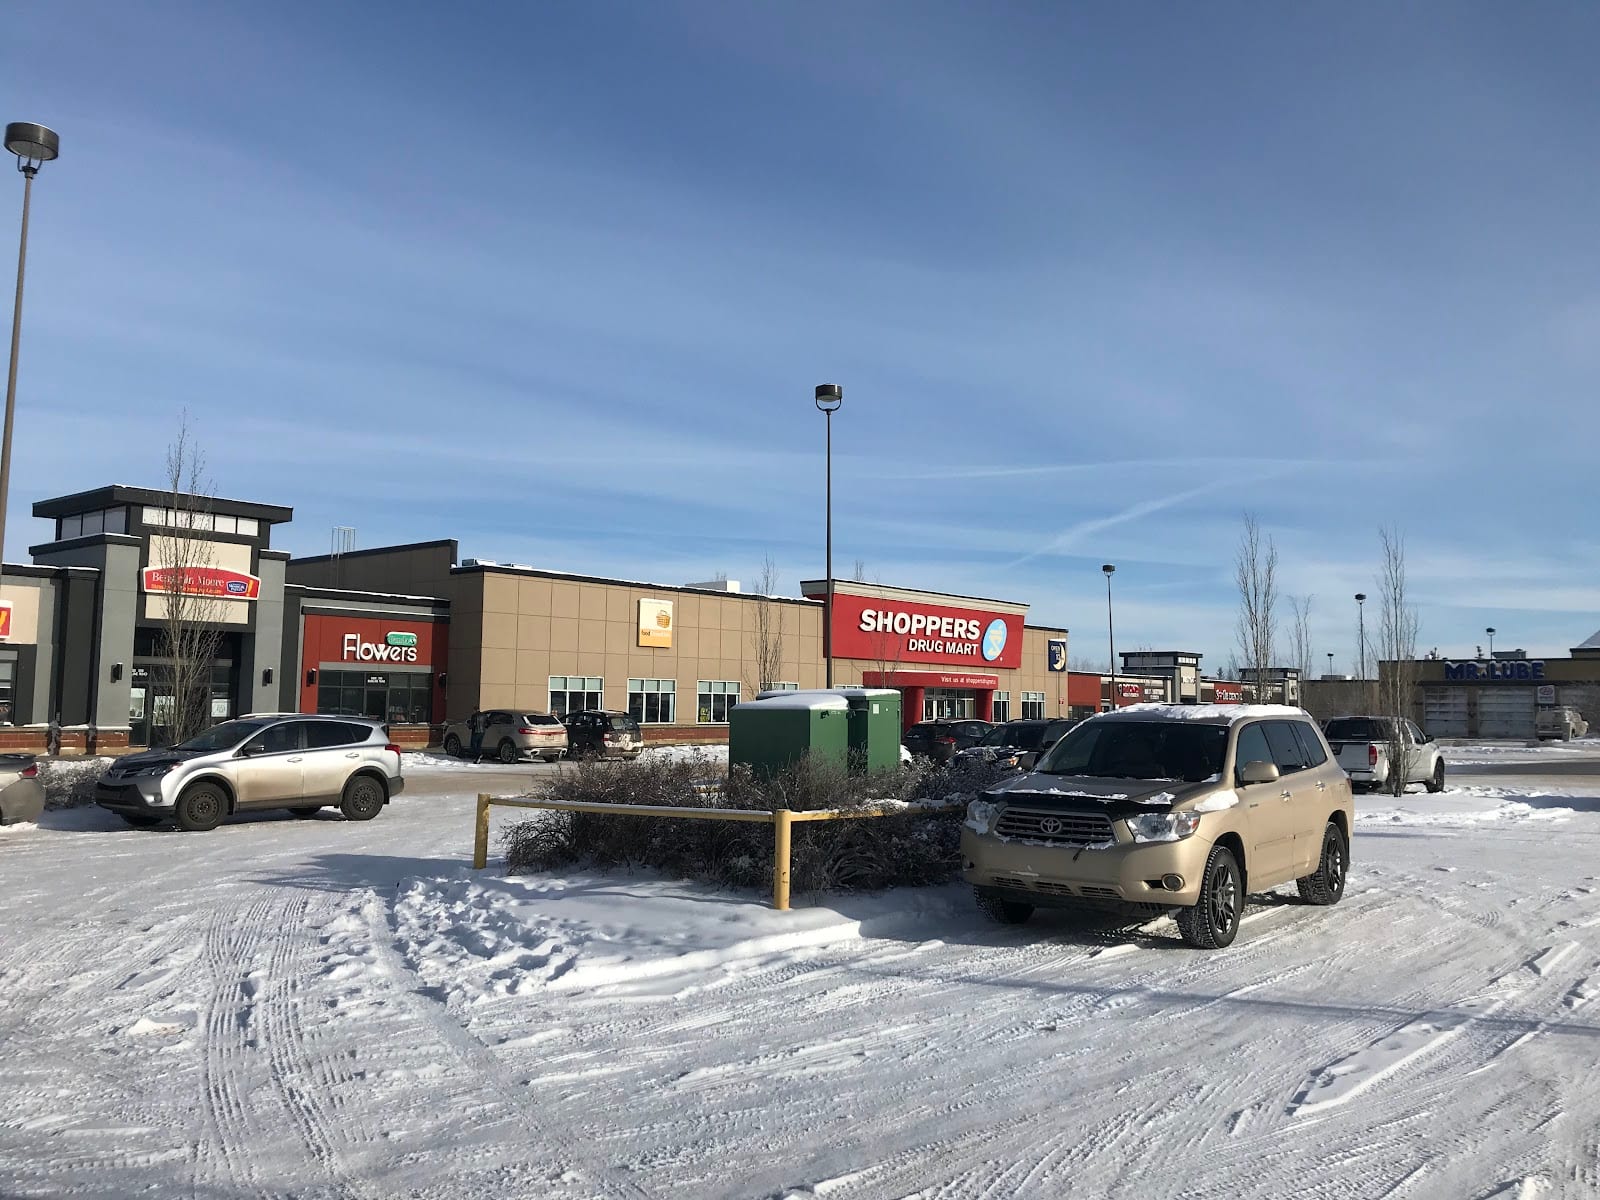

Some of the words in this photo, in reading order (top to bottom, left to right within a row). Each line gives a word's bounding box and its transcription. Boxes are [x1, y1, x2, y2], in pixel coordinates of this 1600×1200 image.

[860, 609, 981, 640] SHOPPERS
[344, 634, 417, 662] Flowers
[908, 639, 943, 653] DRUG
[945, 642, 979, 655] MART
[1489, 660, 1545, 680] LUBE
